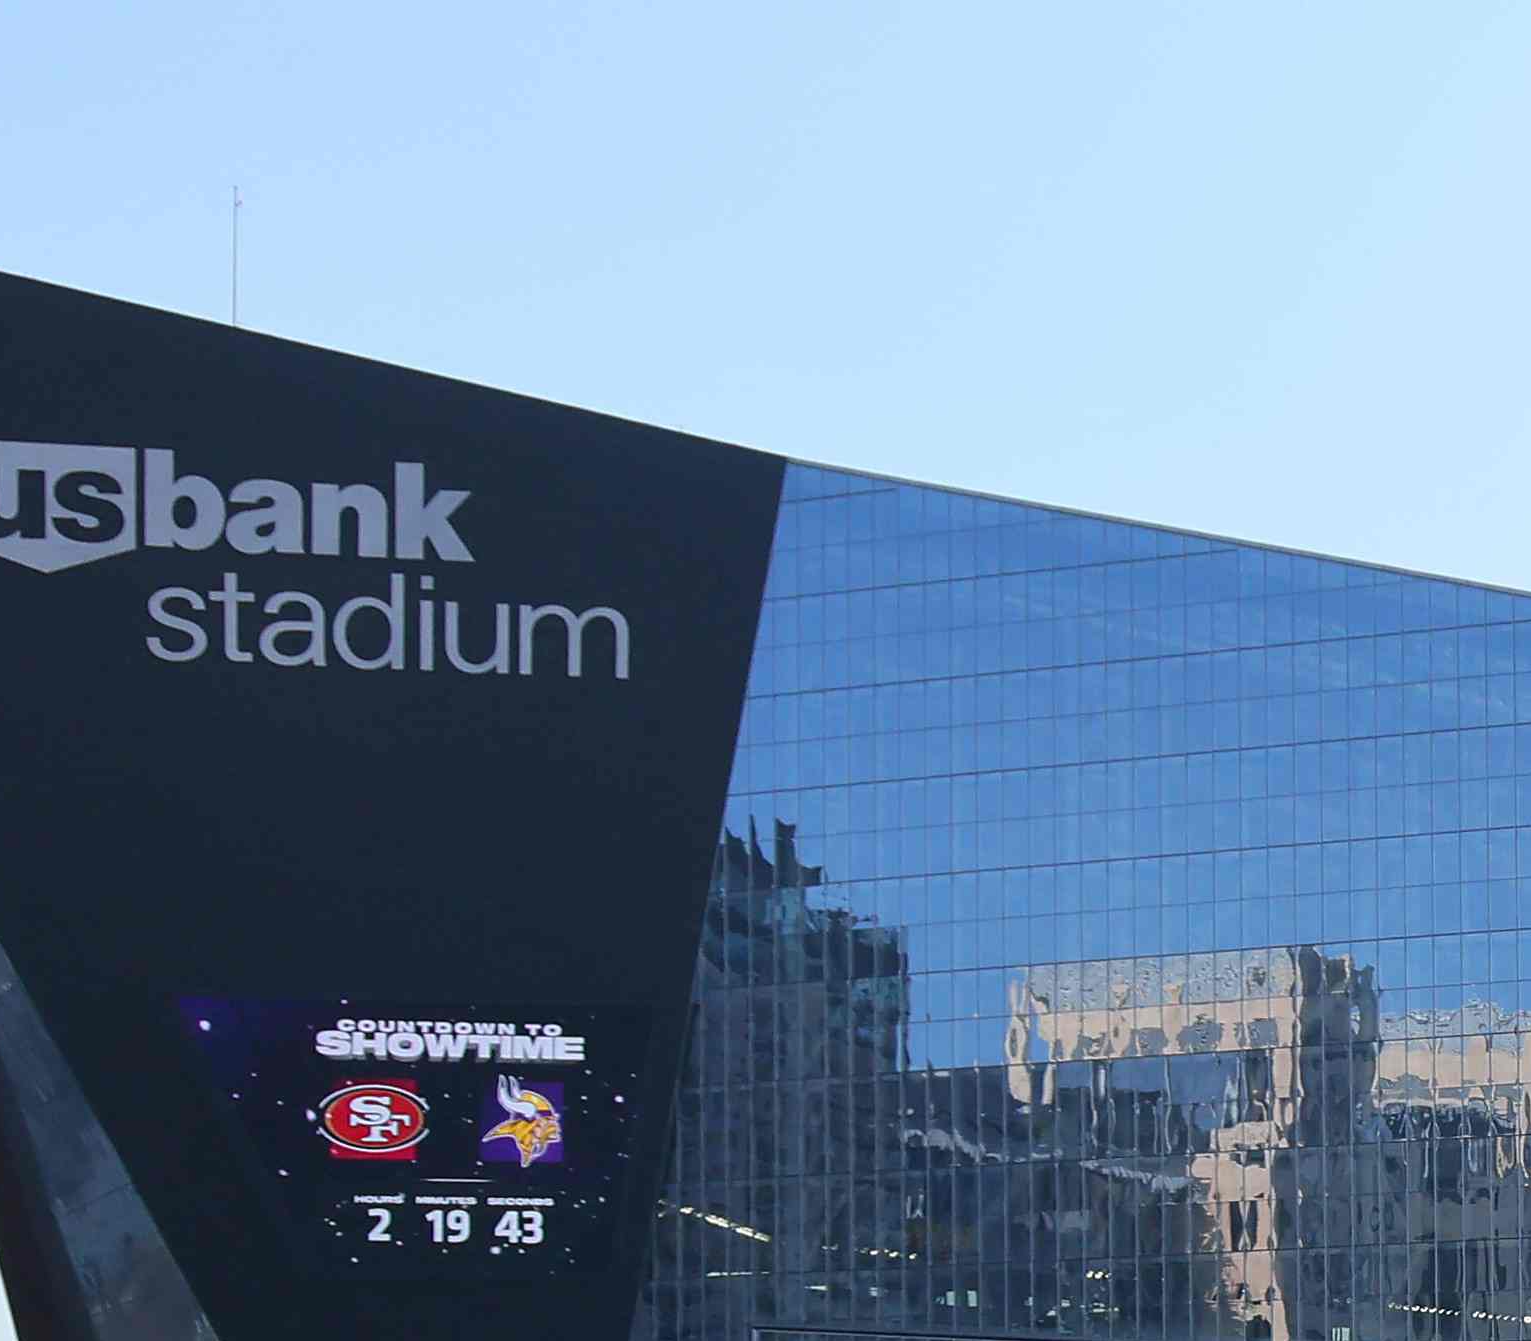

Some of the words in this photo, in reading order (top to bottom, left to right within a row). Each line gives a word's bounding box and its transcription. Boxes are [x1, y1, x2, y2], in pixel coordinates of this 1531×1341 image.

[146, 572, 631, 680] stadium
[337, 1019, 515, 1035] COUNTDOWN
[524, 1023, 563, 1036] TO
[316, 1030, 585, 1061] SHOWTIME
[367, 1208, 392, 1242] 2
[425, 1209, 471, 1243] 19
[494, 1210, 544, 1244] 43
